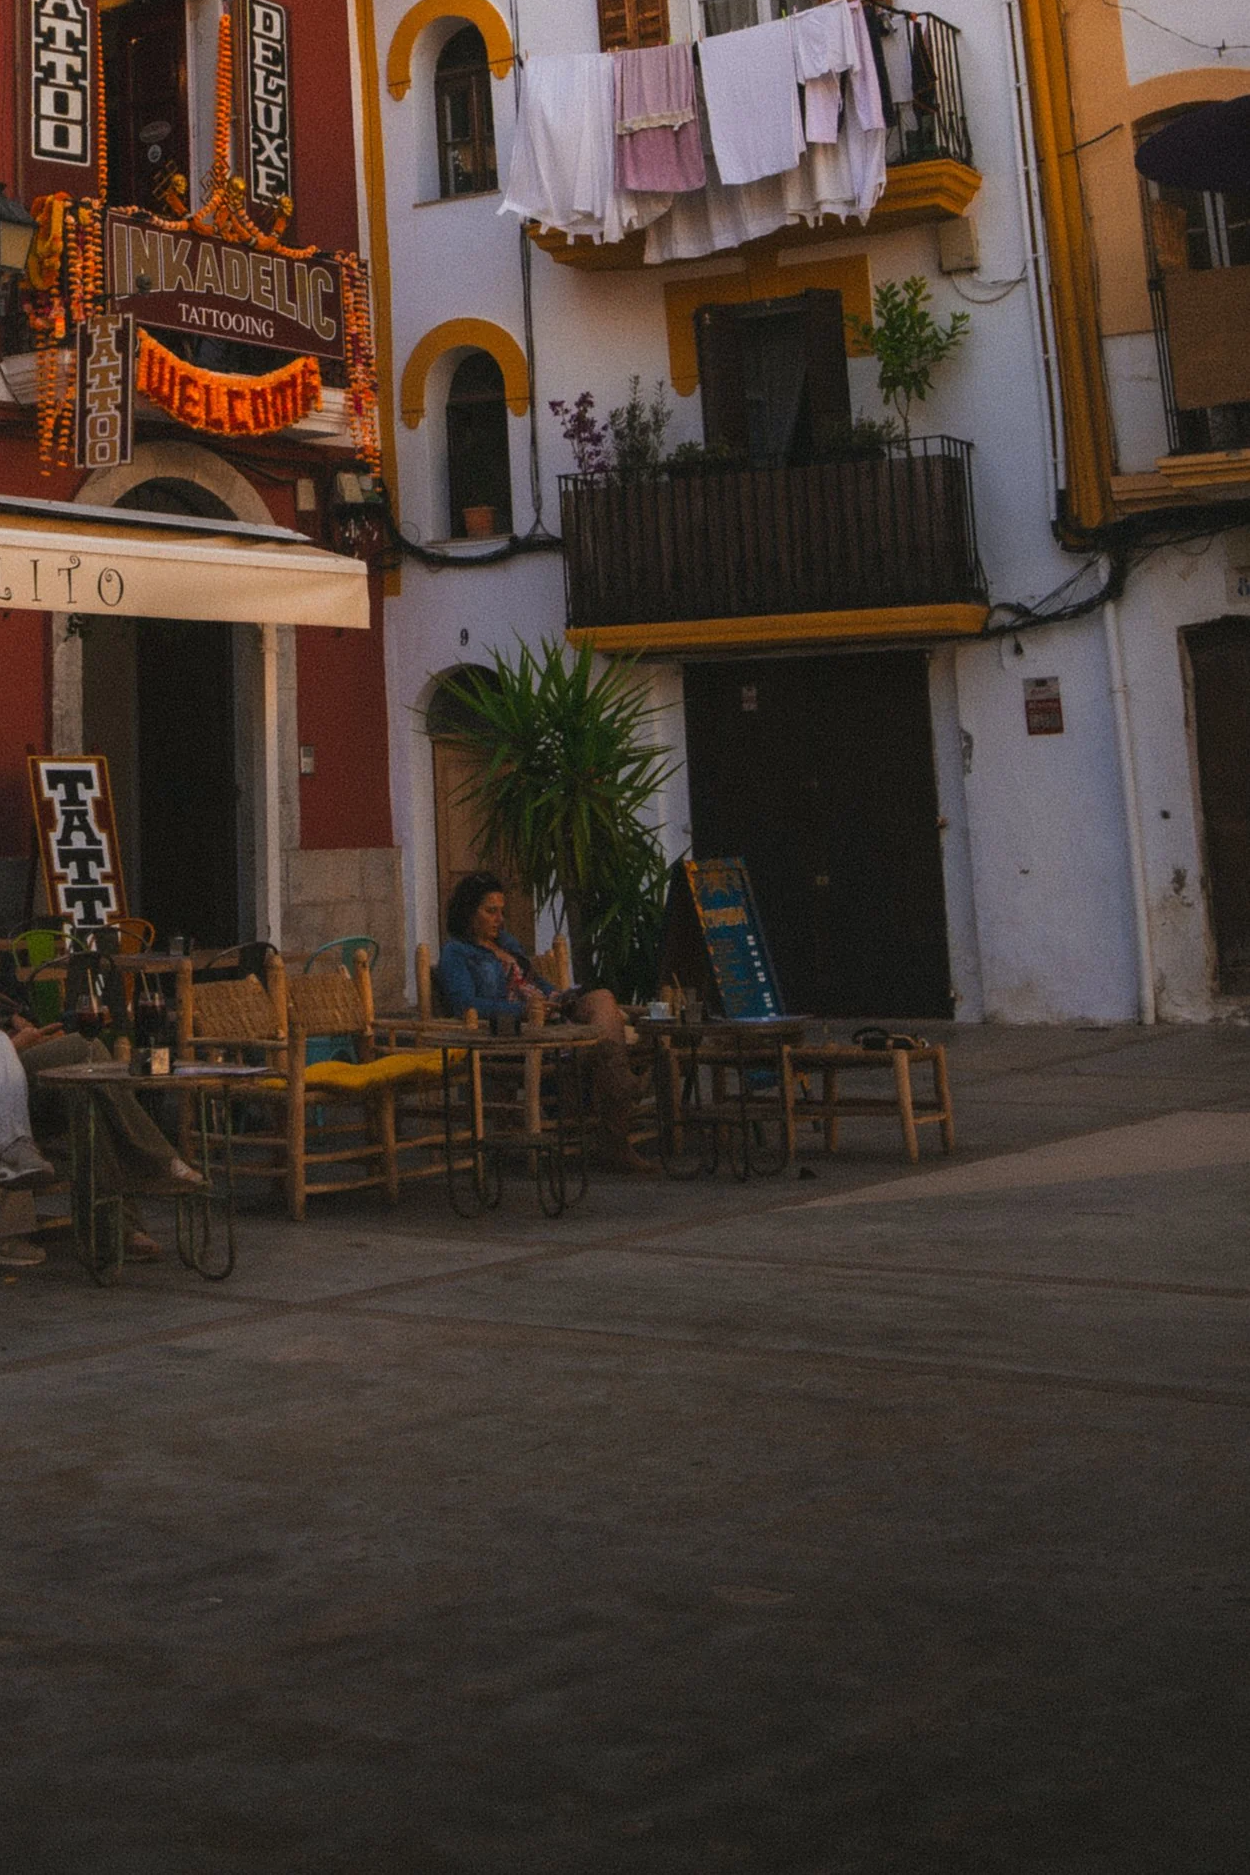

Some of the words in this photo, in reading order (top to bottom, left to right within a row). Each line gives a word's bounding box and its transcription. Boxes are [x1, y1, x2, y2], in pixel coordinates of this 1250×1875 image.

[250, 0, 289, 204] DELUXE
[112, 222, 337, 342] INKADELIC
[178, 302, 275, 339] TATTOOING
[86, 313, 122, 468] TATTOO
[460, 628, 469, 646] 9
[44, 769, 119, 955] TATT
